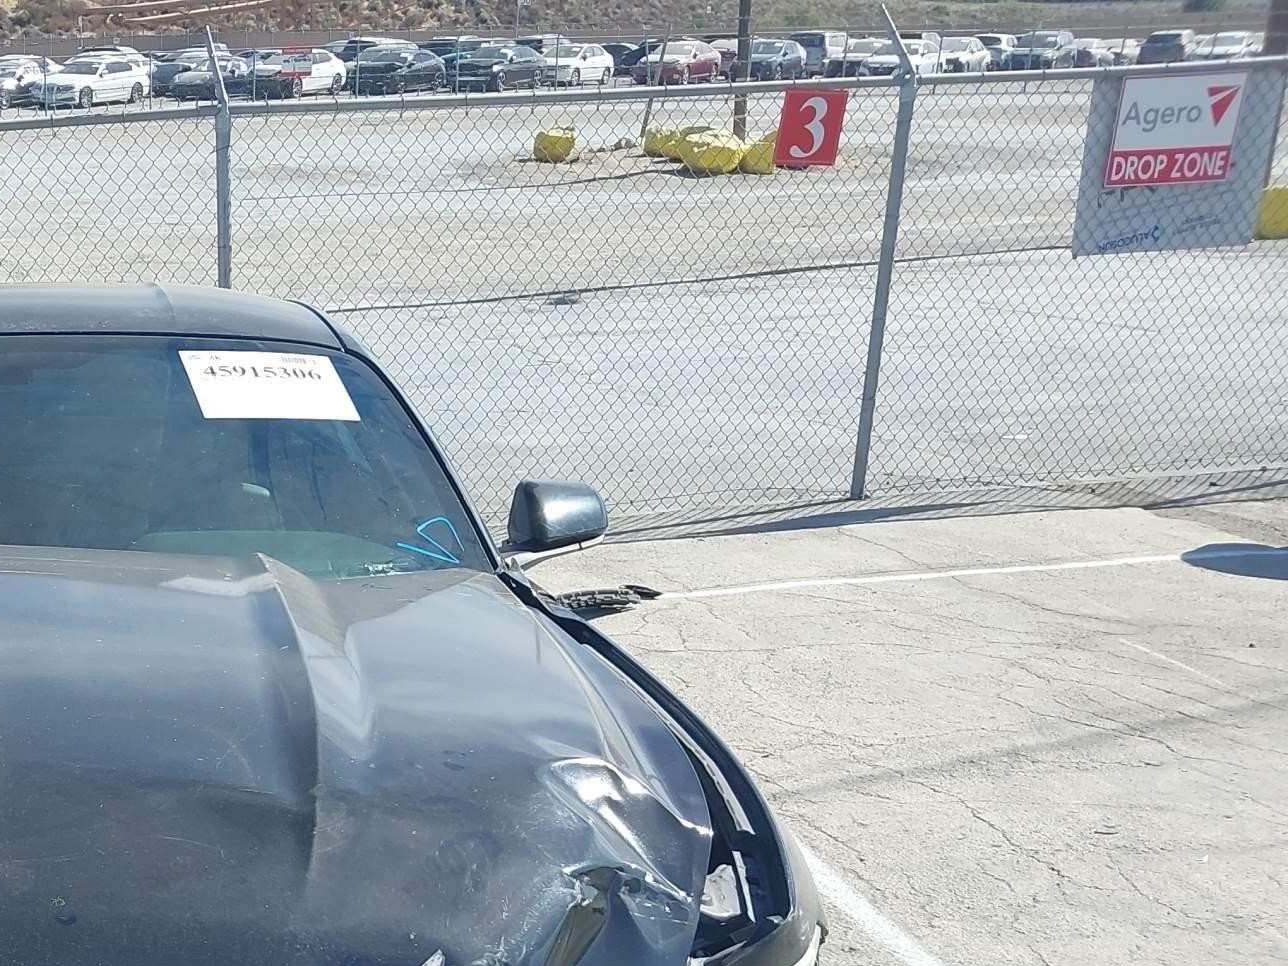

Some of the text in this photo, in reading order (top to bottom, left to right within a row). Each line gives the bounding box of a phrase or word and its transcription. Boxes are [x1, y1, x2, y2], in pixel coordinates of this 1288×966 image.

[789, 96, 828, 158] 3
[1121, 101, 1202, 133] Agero
[1110, 150, 1228, 181] DROP ZONE
[202, 364, 322, 381] 45915306
